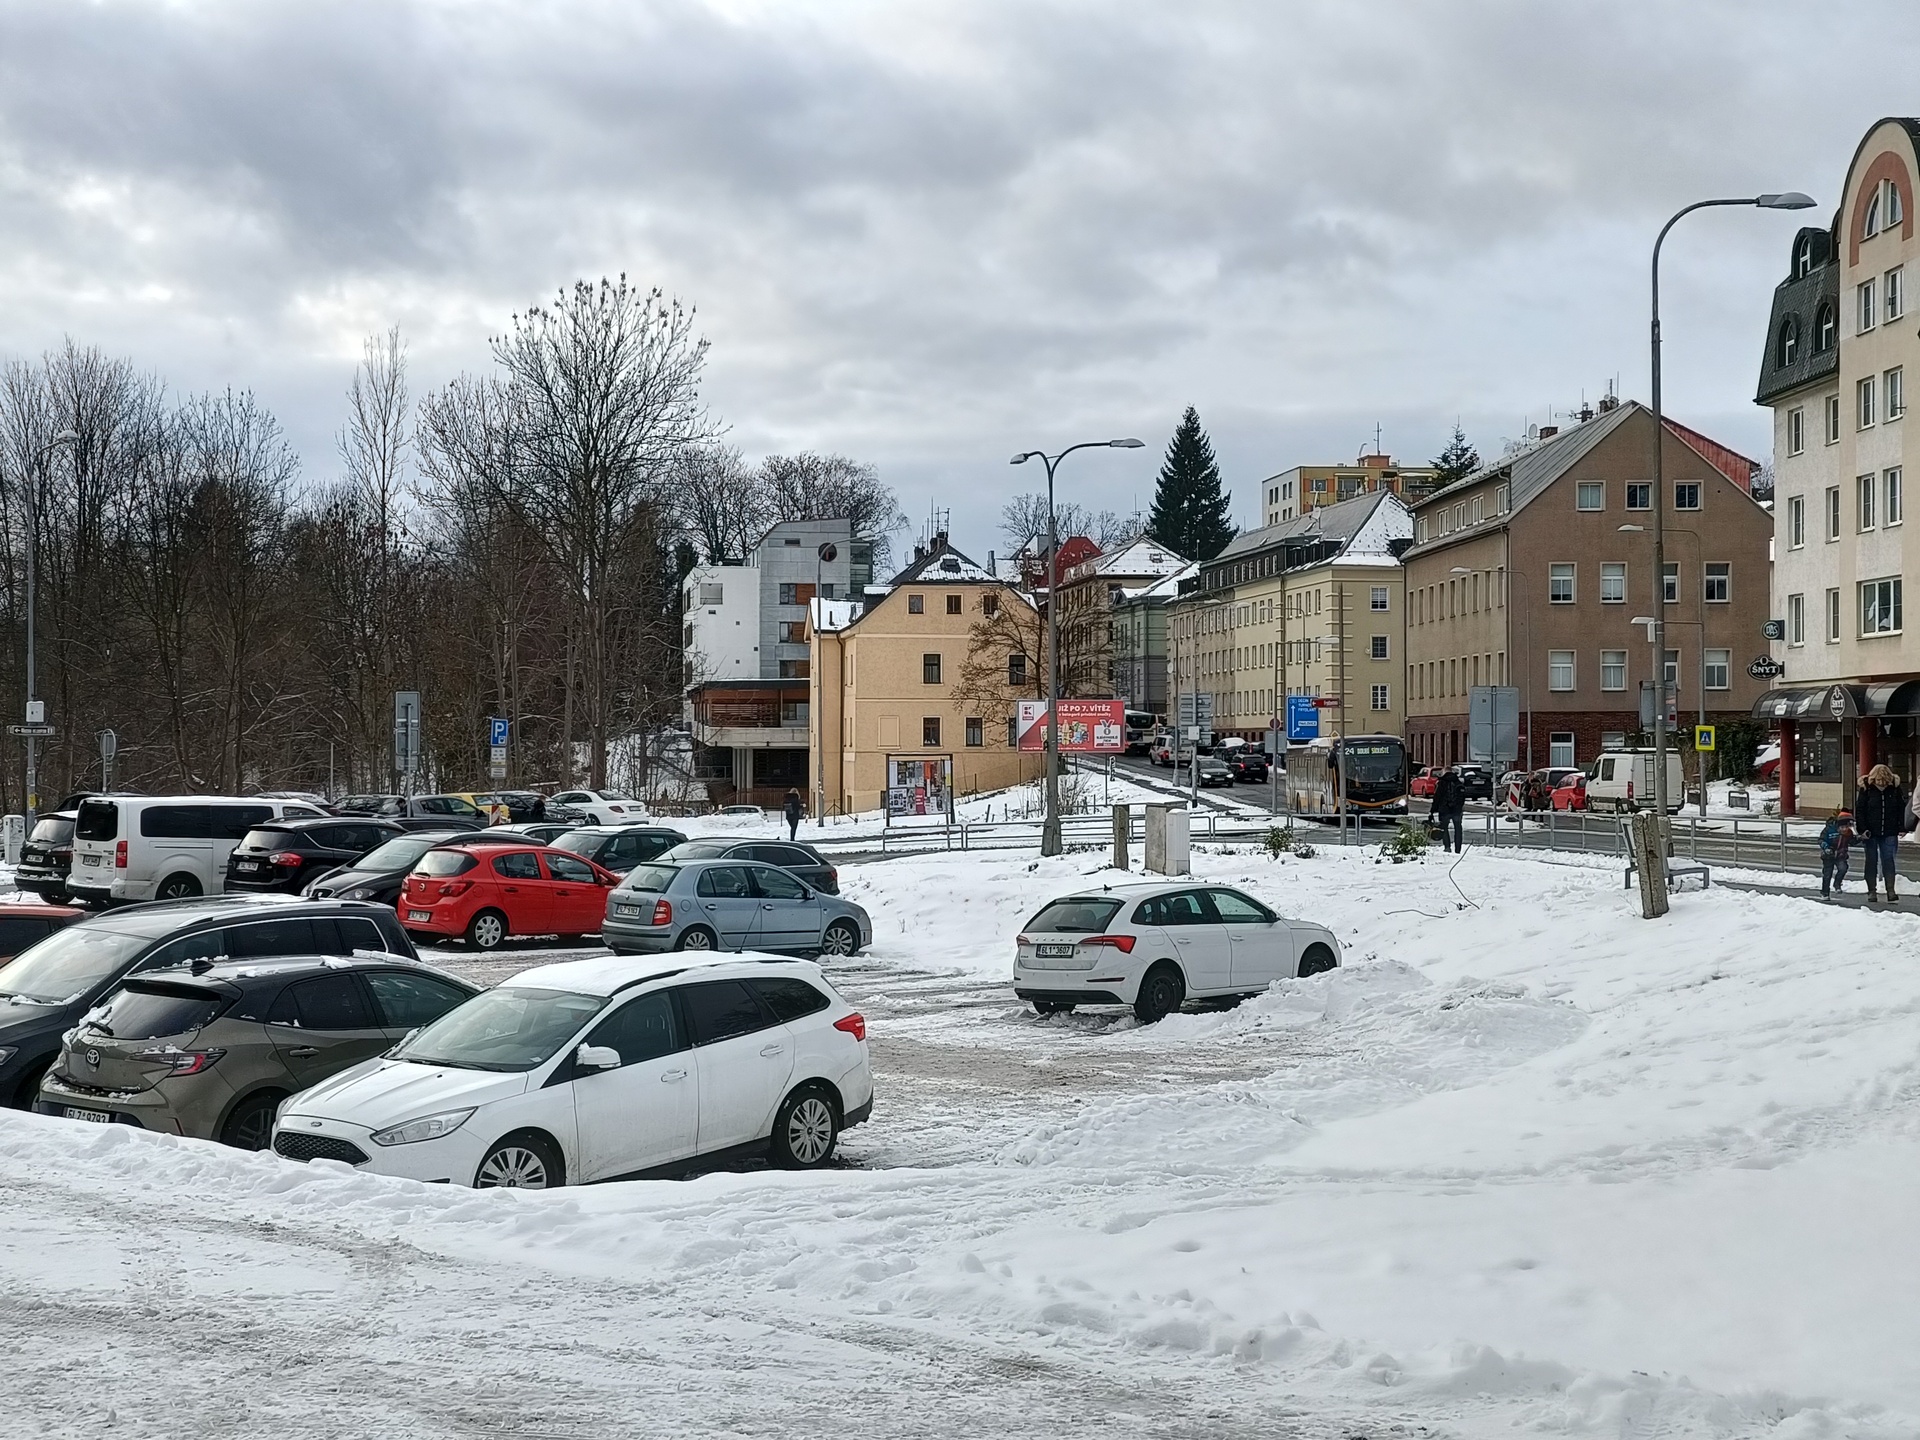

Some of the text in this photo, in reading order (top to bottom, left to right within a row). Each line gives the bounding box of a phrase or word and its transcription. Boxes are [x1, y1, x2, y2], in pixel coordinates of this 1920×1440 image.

[1751, 664, 1777, 674] ŠNYT
[1058, 704, 1068, 712] JIŽ
[1089, 703, 1111, 712] VÍTĚZ
[494, 722, 505, 738] P
[1344, 747, 1355, 755] 24
